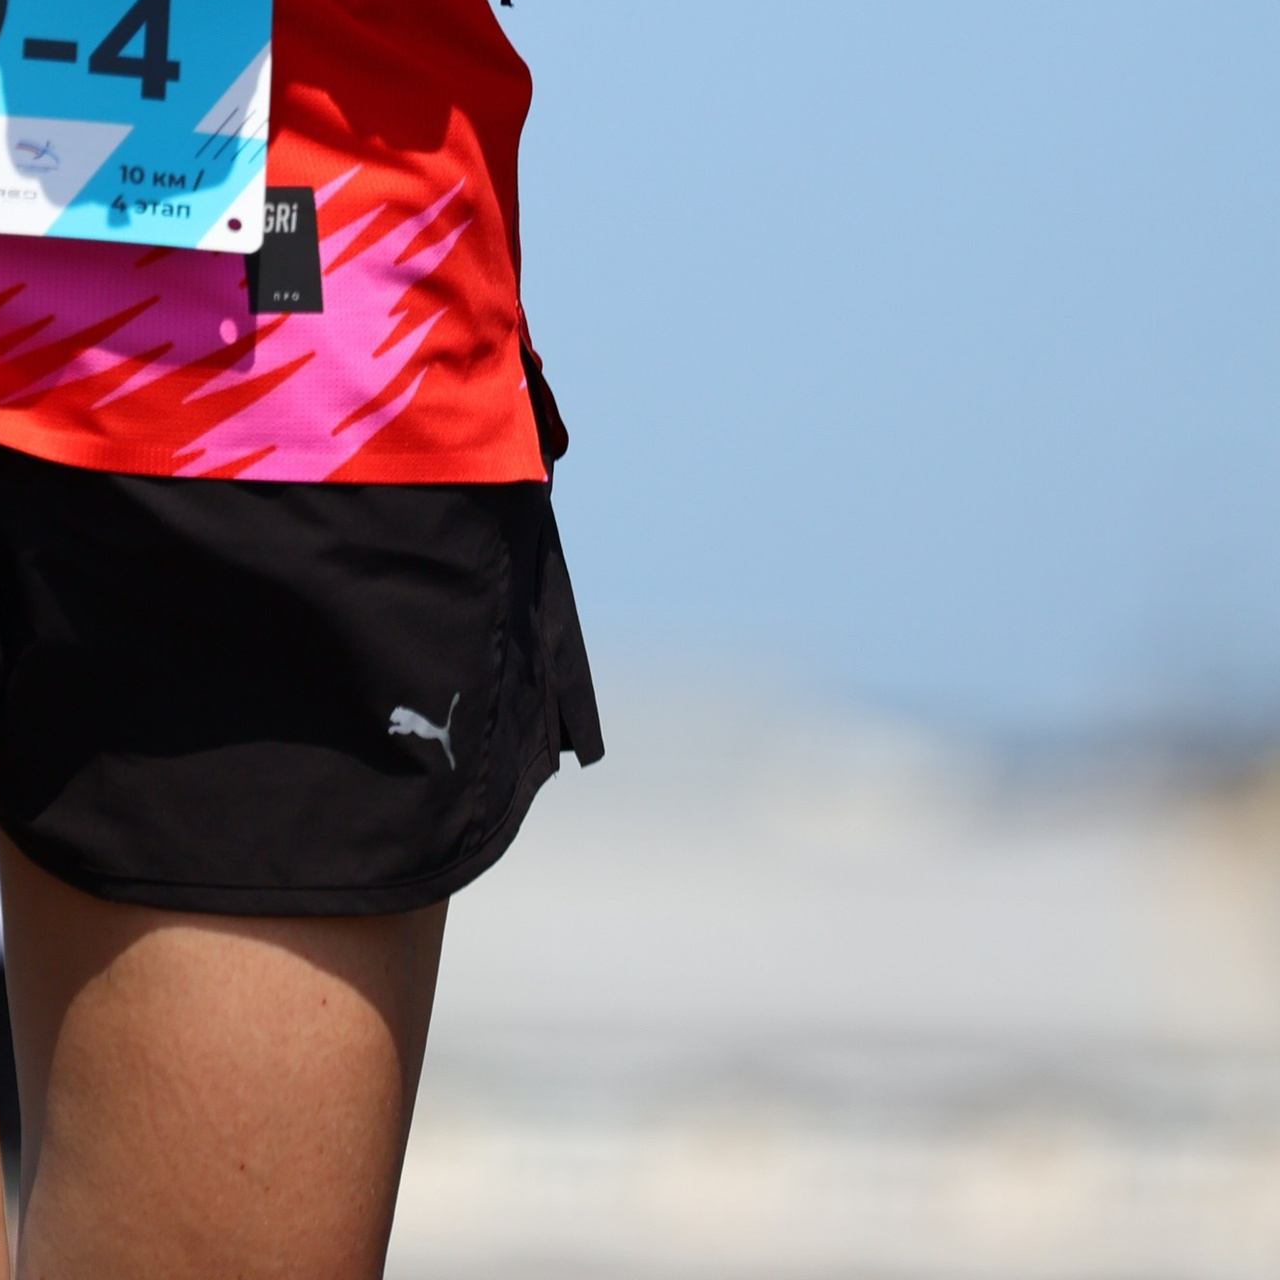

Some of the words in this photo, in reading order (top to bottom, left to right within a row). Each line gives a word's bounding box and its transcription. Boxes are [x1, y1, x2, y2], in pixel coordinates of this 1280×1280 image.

[119, 164, 144, 184] 10
[153, 171, 186, 188] км
[193, 168, 205, 191] /
[111, 194, 127, 213] 4
[134, 198, 191, 218] этап
